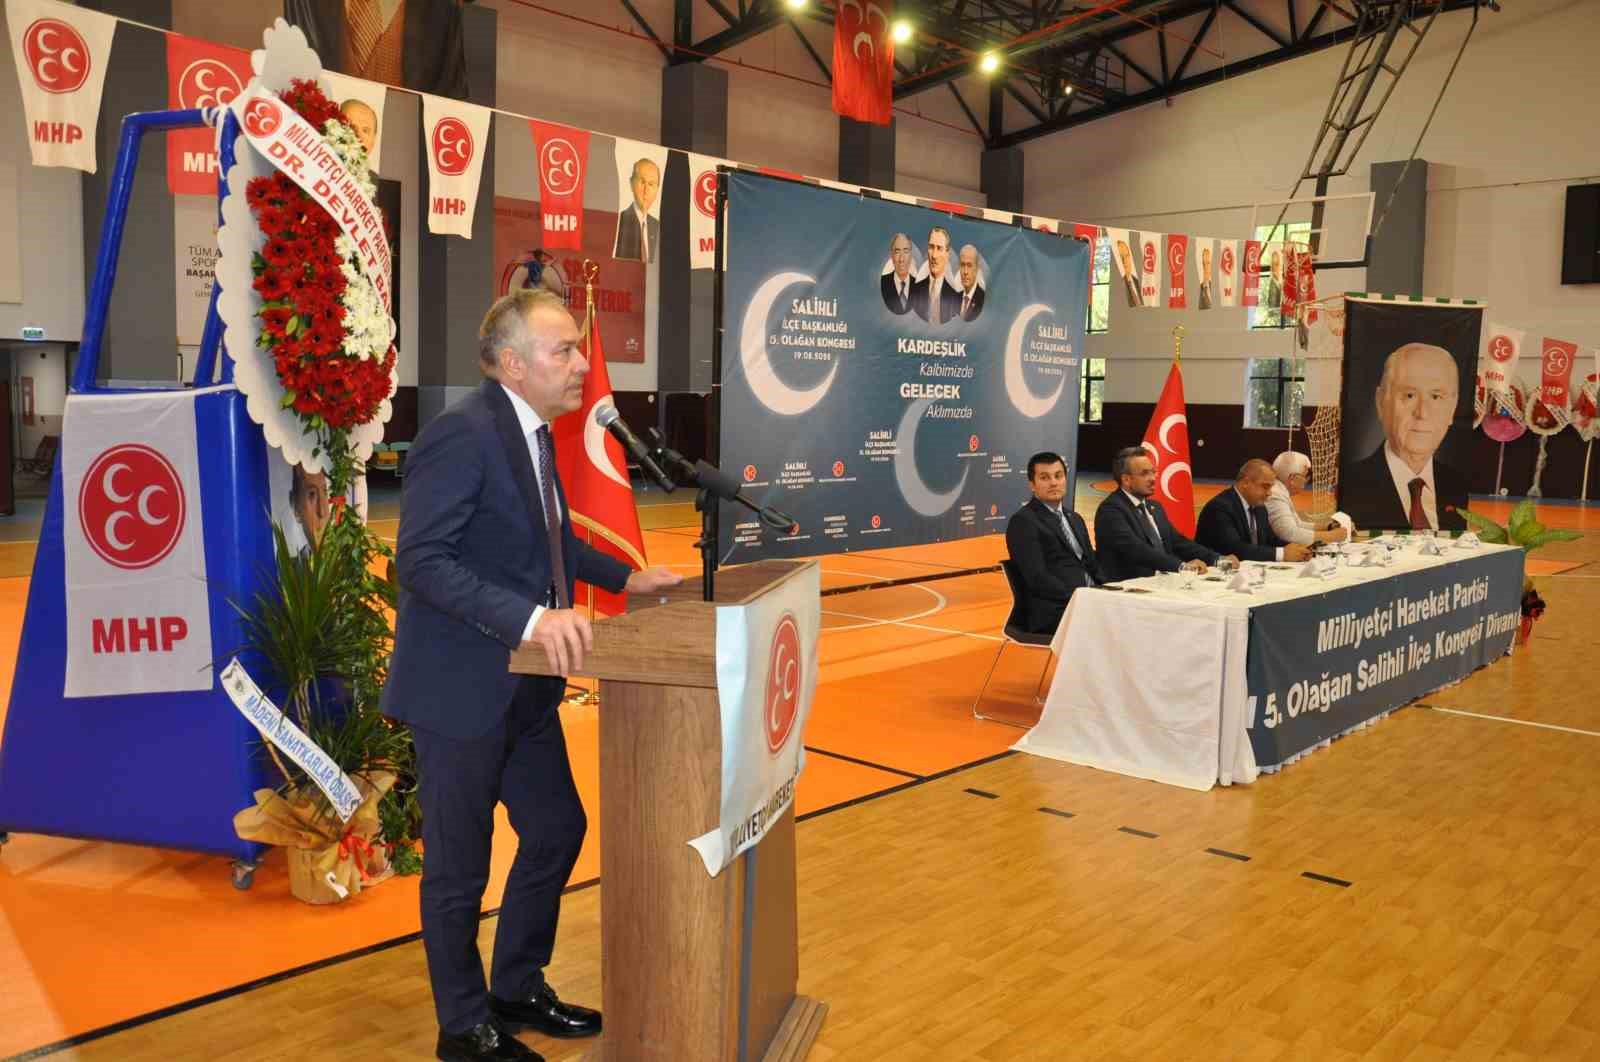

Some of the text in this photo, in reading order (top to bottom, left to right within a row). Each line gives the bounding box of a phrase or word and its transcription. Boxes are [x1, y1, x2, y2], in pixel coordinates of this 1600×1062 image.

[34, 120, 82, 144] MHP
[268, 141, 305, 179] DR.
[313, 180, 377, 268] DEVLET
[432, 196, 466, 216] MHP
[544, 213, 577, 231] MHP
[791, 296, 837, 316] SALİHLİ
[897, 337, 967, 358] KARDEŞLİK
[919, 363, 975, 379] Kalbimizde
[900, 382, 961, 399] GELECEK
[926, 404, 974, 419] Aklımızda
[1317, 575, 1489, 655] Milliyetçi Hareket Partisi
[92, 616, 189, 655] MHP
[1286, 669, 1352, 719] Olağan
[1357, 645, 1405, 693] Salihli
[1408, 635, 1431, 671] İlçe
[1435, 616, 1484, 660] Kongresi
